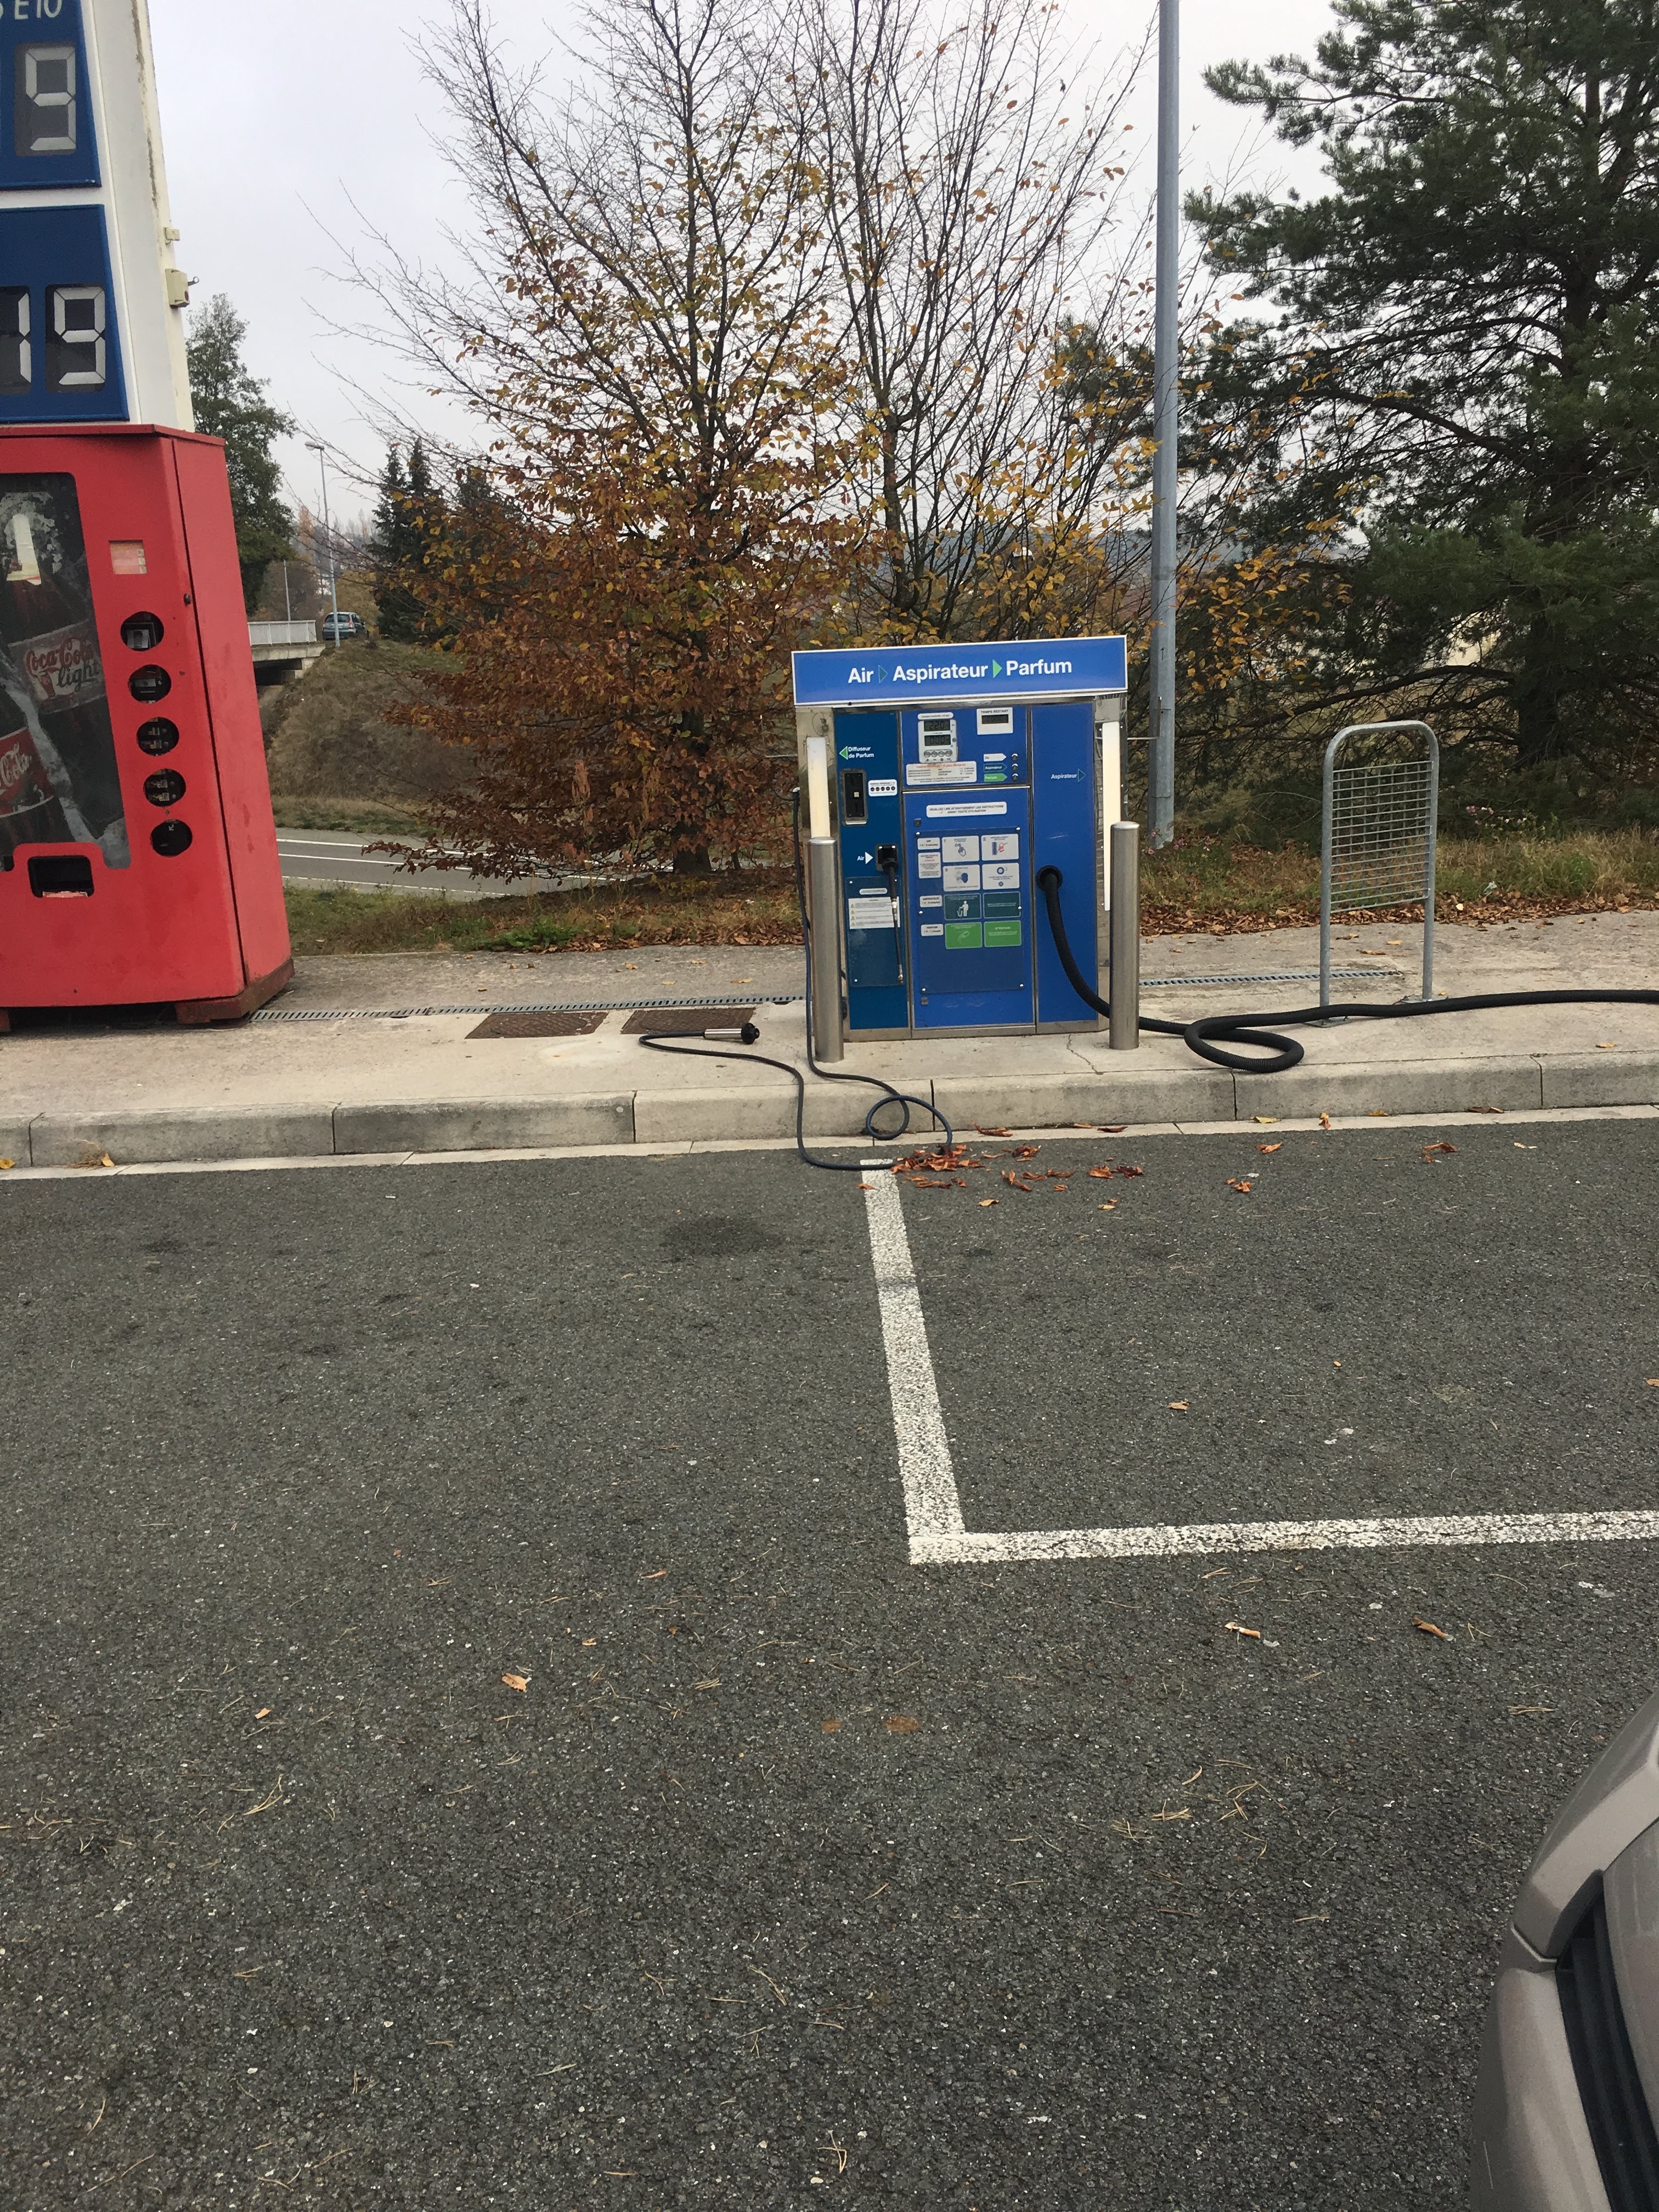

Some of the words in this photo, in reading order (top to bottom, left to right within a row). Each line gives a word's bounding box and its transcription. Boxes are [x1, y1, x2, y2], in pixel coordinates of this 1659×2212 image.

[26, 634, 94, 678] Coca-Cola
[848, 668, 874, 683] Air
[893, 664, 988, 684] Aspirateur
[1006, 659, 1072, 676] Parfum
